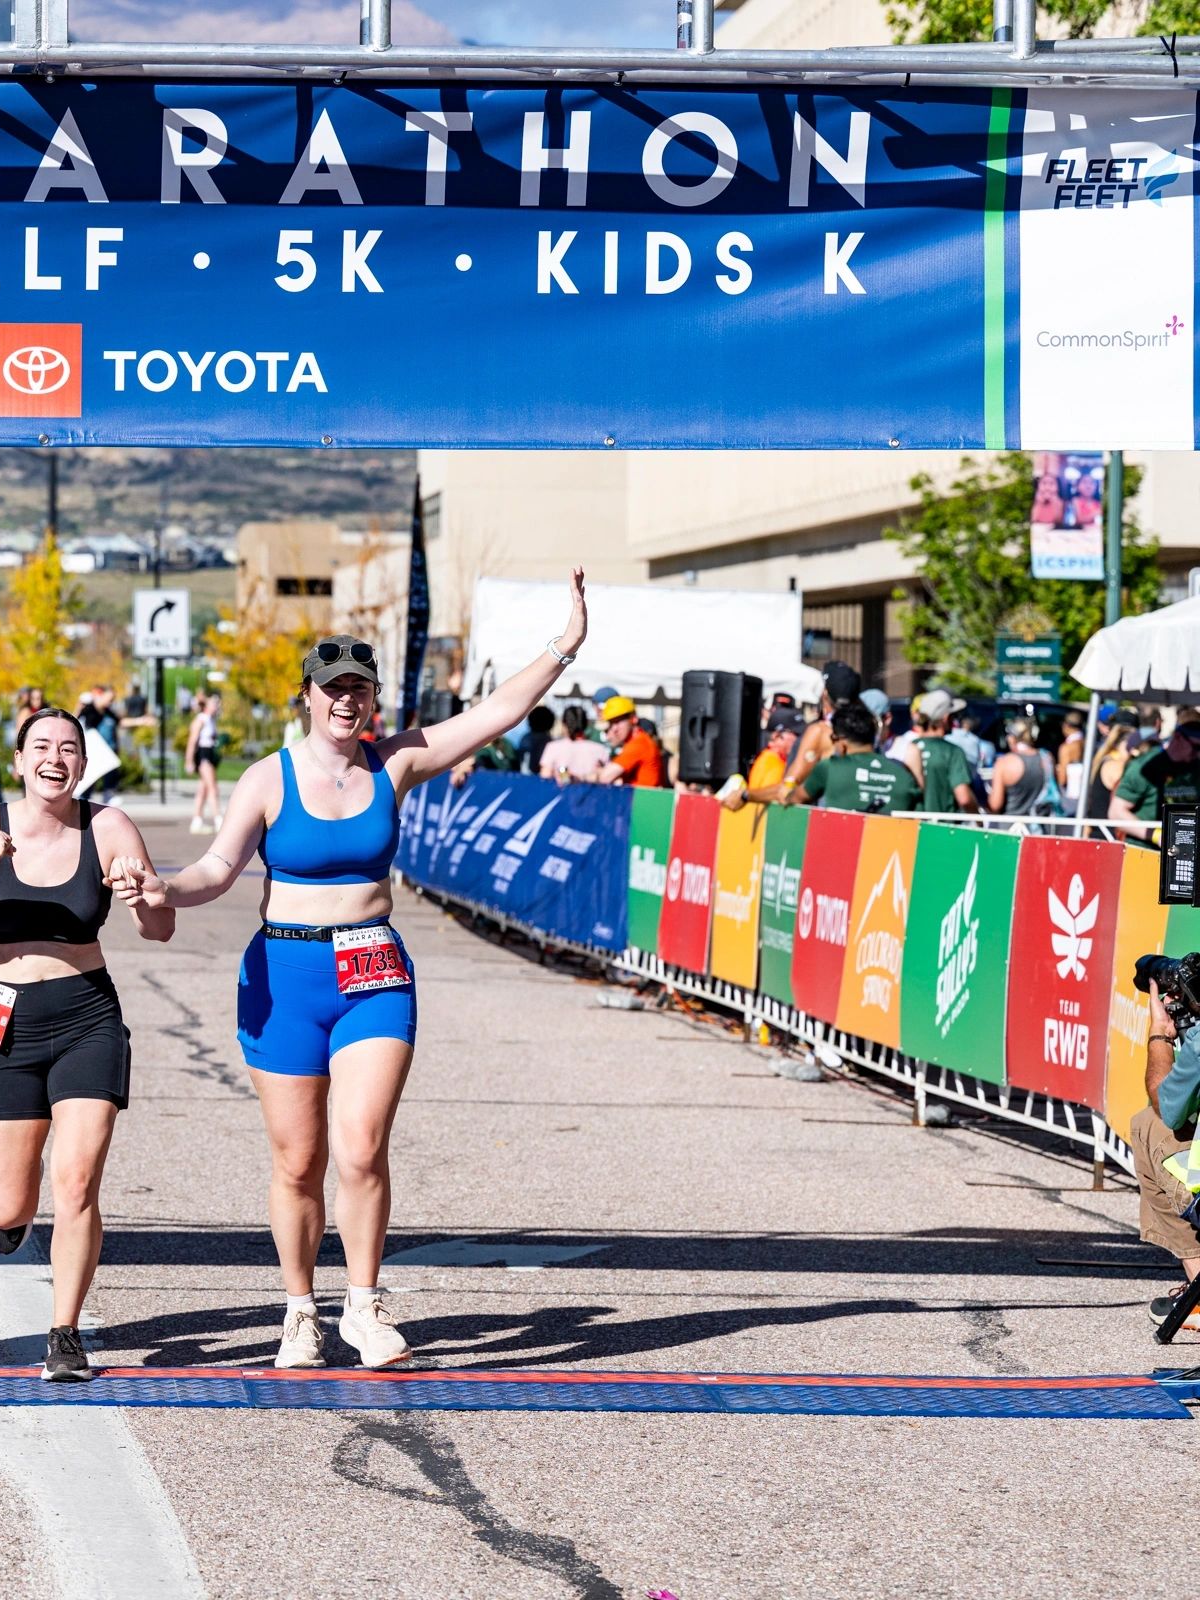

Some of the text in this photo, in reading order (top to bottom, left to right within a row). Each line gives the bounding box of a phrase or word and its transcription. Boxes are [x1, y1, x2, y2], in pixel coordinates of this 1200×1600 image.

[1045, 158, 1147, 184] FLEET
[1054, 185, 1138, 210] FEET
[274, 230, 384, 293] 5K
[537, 231, 753, 294] KIDS
[823, 232, 867, 294] K
[1036, 331, 1170, 351] CommonSpirit
[104, 350, 328, 393] TOYOTA
[816, 894, 849, 947] TOYOTA
[351, 949, 398, 975] 1735
[349, 978, 405, 992] HALF MARATHON
[1059, 999, 1080, 1017] TEAM
[1044, 1018, 1089, 1071] RWB
